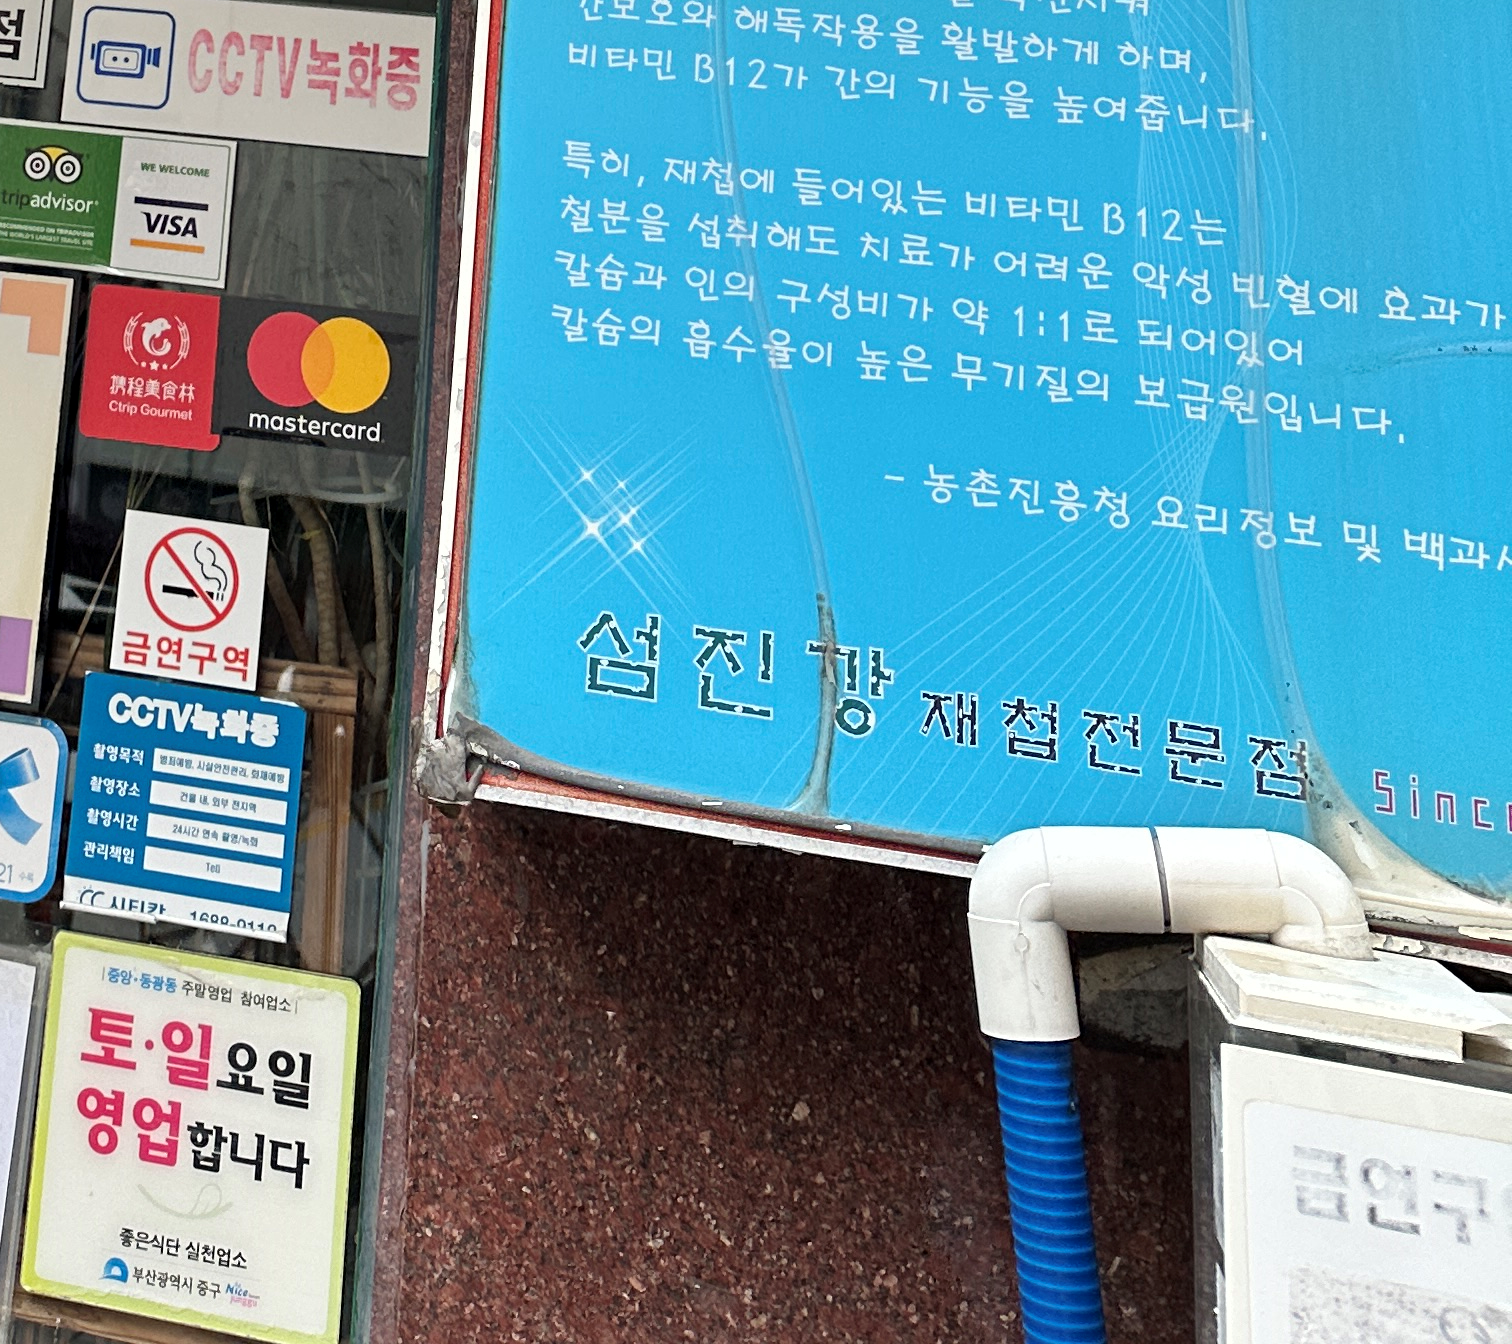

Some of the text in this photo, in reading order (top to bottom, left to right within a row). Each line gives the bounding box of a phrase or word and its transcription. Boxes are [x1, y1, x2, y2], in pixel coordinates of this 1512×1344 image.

[188, 28, 420, 112] CCTV녹화중
[734, 5, 924, 55] 해독작용을
[941, 20, 1099, 64] 활발하게
[1117, 42, 1207, 84] 하며,
[568, 42, 1268, 141] 비타민 B12가 간의 기능을 높여줍니다.
[140, 163, 210, 178] WE WELCOME
[562, 139, 1227, 246] 특히, 재첩에 들어있는 비타민 B12는
[1, 189, 93, 213] tripadvisor
[140, 211, 198, 238] VISA
[560, 195, 1507, 330] 철분을 섭취해도 치료가 어려운 악성 빈혈에 효과가
[554, 250, 667, 292] 칼슘과
[685, 266, 755, 302] 인의
[776, 279, 933, 321] 구성비가
[951, 298, 990, 336] 약
[1138, 319, 1303, 367] 되어있어
[551, 304, 1405, 443] 칼슘의 흡수율이 높은 무기질의 보급원입니다.
[109, 400, 193, 421] Ctrip Gourmet
[248, 410, 382, 443] mastercard
[922, 463, 1382, 563] 농촌진흥청 요리정보 및
[121, 630, 250, 681] 금연구역
[108, 692, 280, 747] CCTV녹화중
[919, 689, 1315, 804] 재첩전문점
[90, 776, 141, 797] 촬영장소
[86, 808, 138, 831] 촬영시간
[83, 841, 135, 864] 관리책임
[182, 980, 232, 1003] 주말영업
[241, 990, 291, 1012] 참여업소
[80, 1006, 312, 1110] 토·일요일
[76, 1086, 310, 1190] 영업합니다
[1291, 1144, 1512, 1246] 금연구
[118, 1227, 248, 1270] 좋은식단 실천업소
[132, 1266, 221, 1299] 부산광역시 중구
